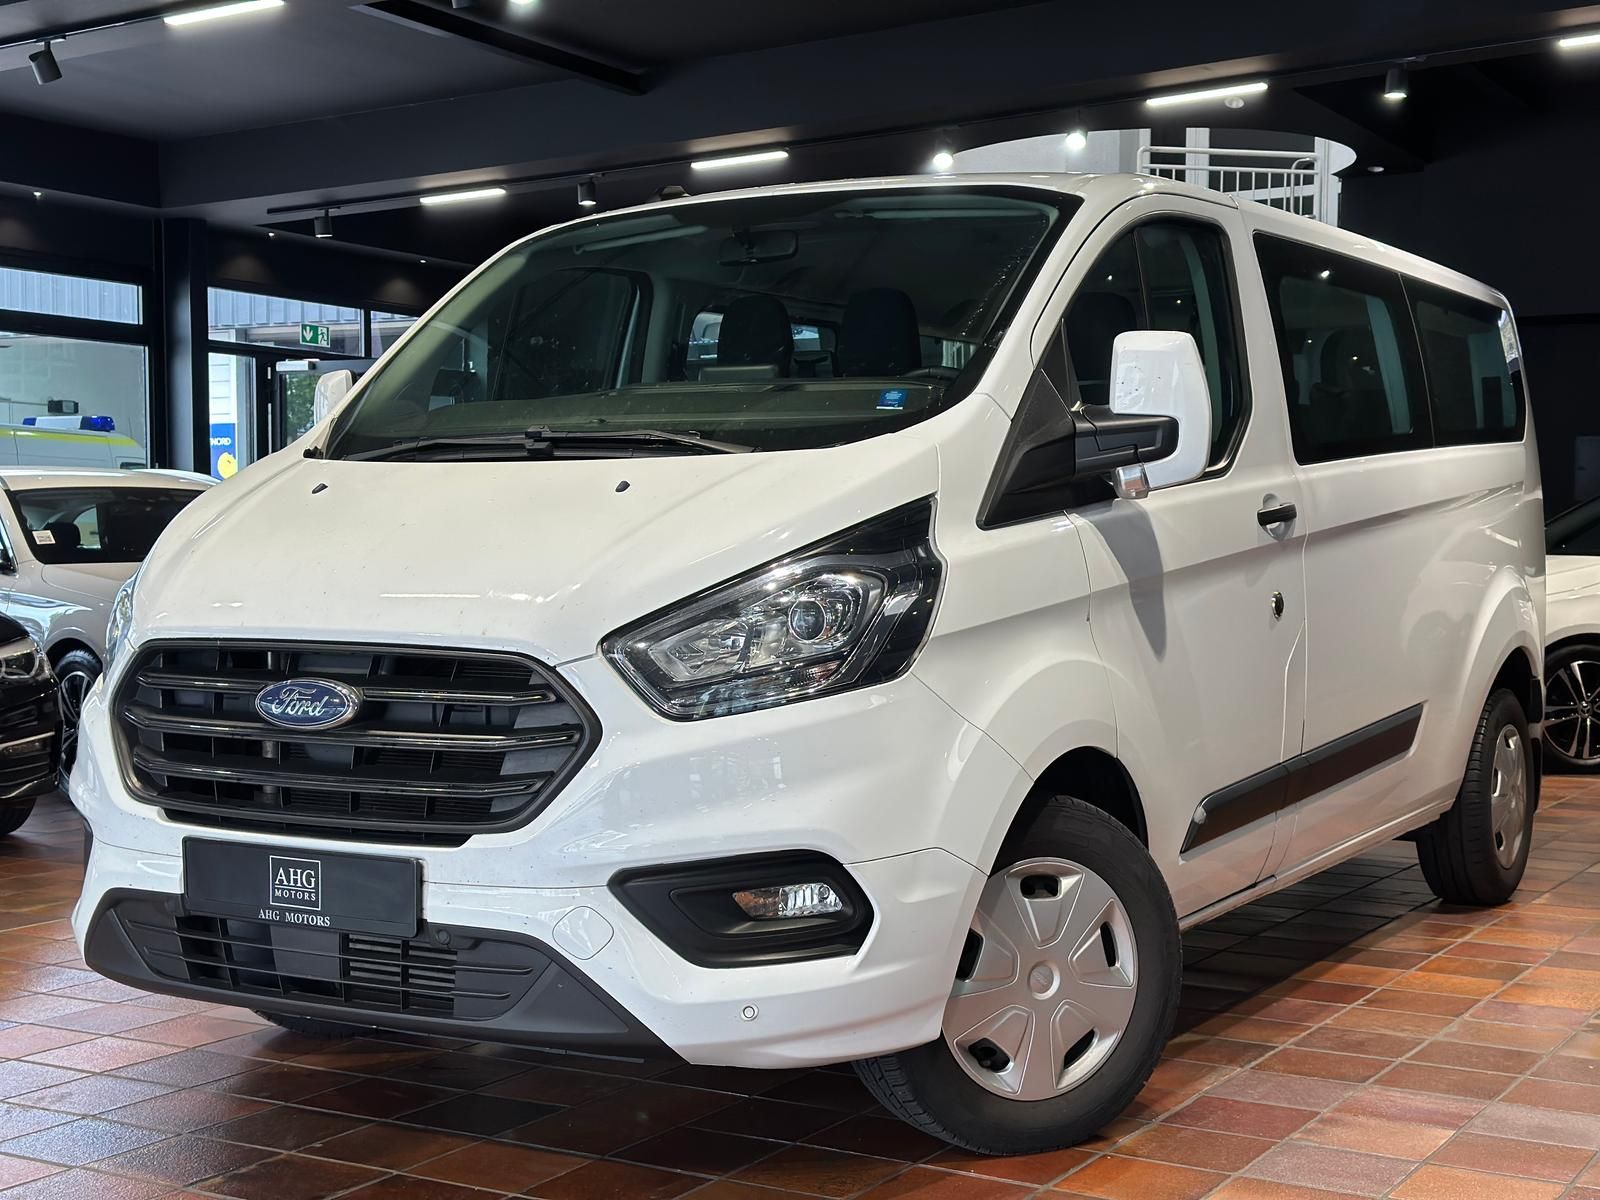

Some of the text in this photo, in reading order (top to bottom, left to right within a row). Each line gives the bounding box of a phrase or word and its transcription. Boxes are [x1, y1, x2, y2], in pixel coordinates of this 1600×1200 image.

[272, 686, 329, 716] Ford
[274, 866, 316, 888] AHG
[274, 889, 316, 901] MOTORS
[258, 908, 331, 927] AHG MOTORS
